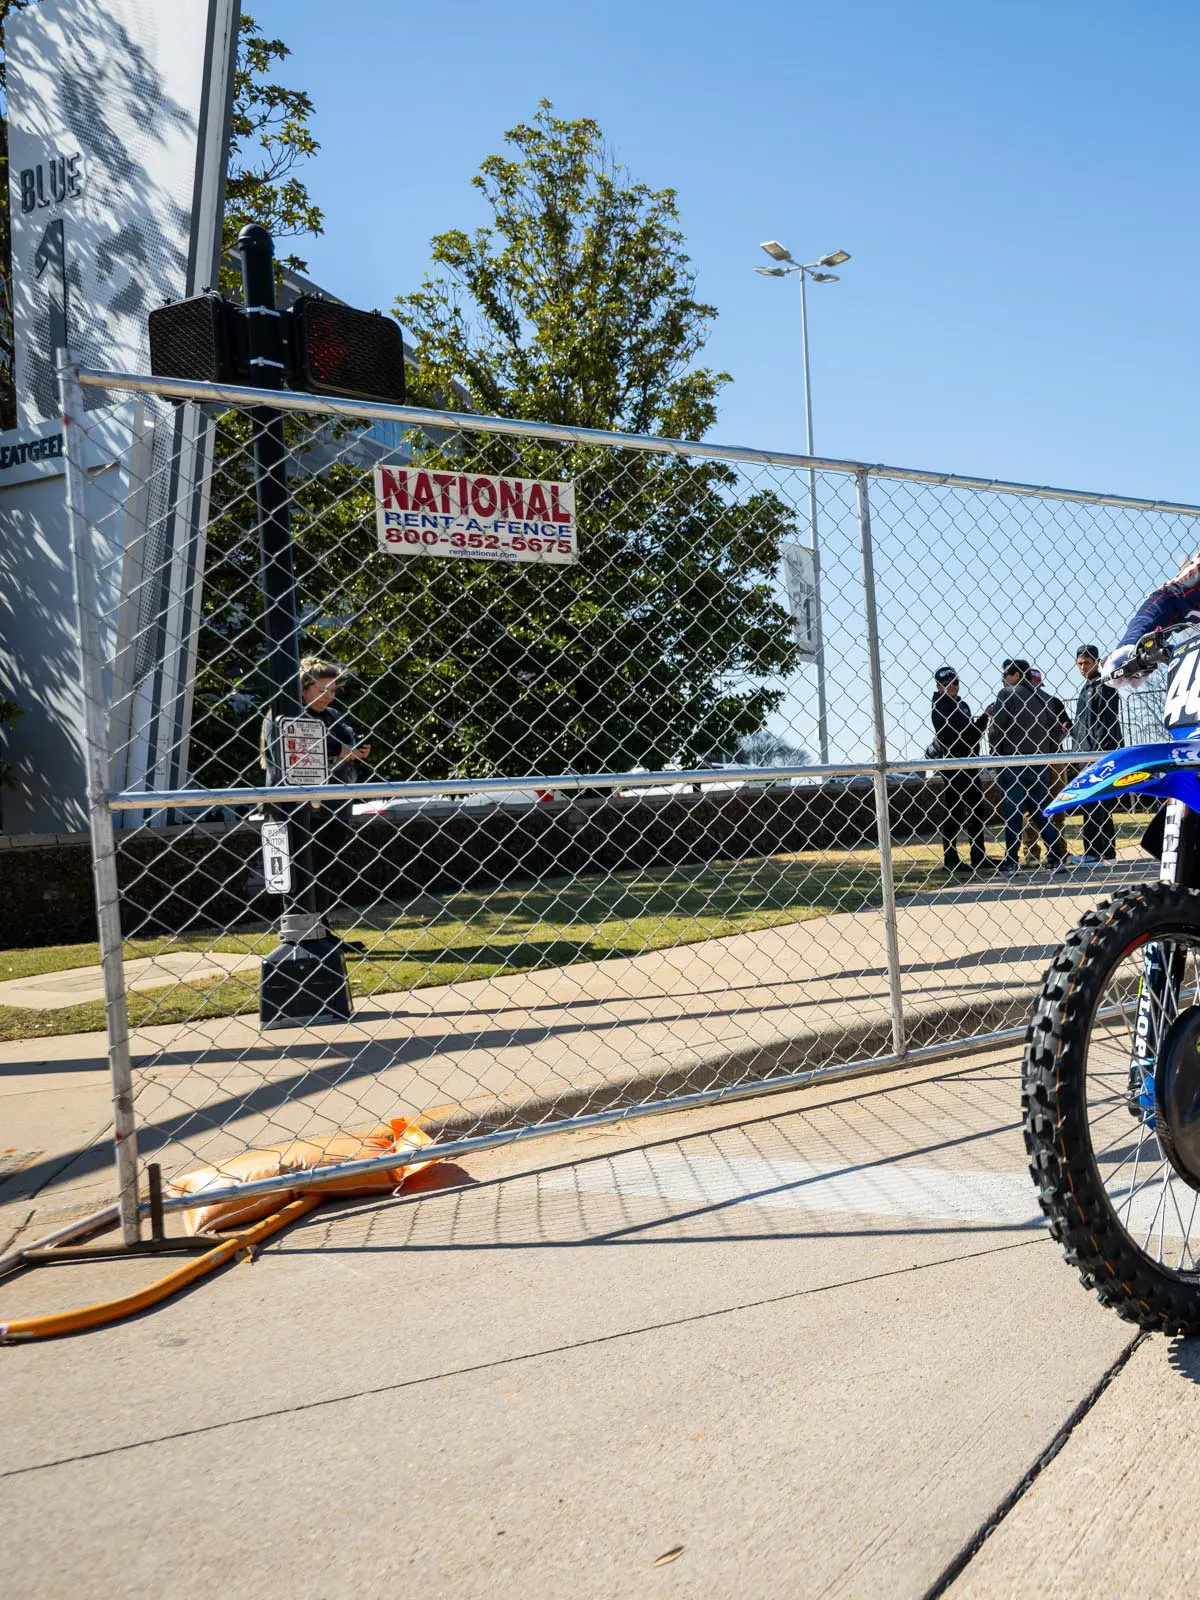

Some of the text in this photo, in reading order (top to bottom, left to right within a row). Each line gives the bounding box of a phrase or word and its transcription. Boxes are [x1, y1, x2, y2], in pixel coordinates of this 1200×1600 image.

[20, 152, 81, 214] BLUE
[382, 469, 571, 523] NATIONAL
[384, 512, 572, 538] RENT-A-FENCE
[385, 528, 572, 554] 800-352-5675
